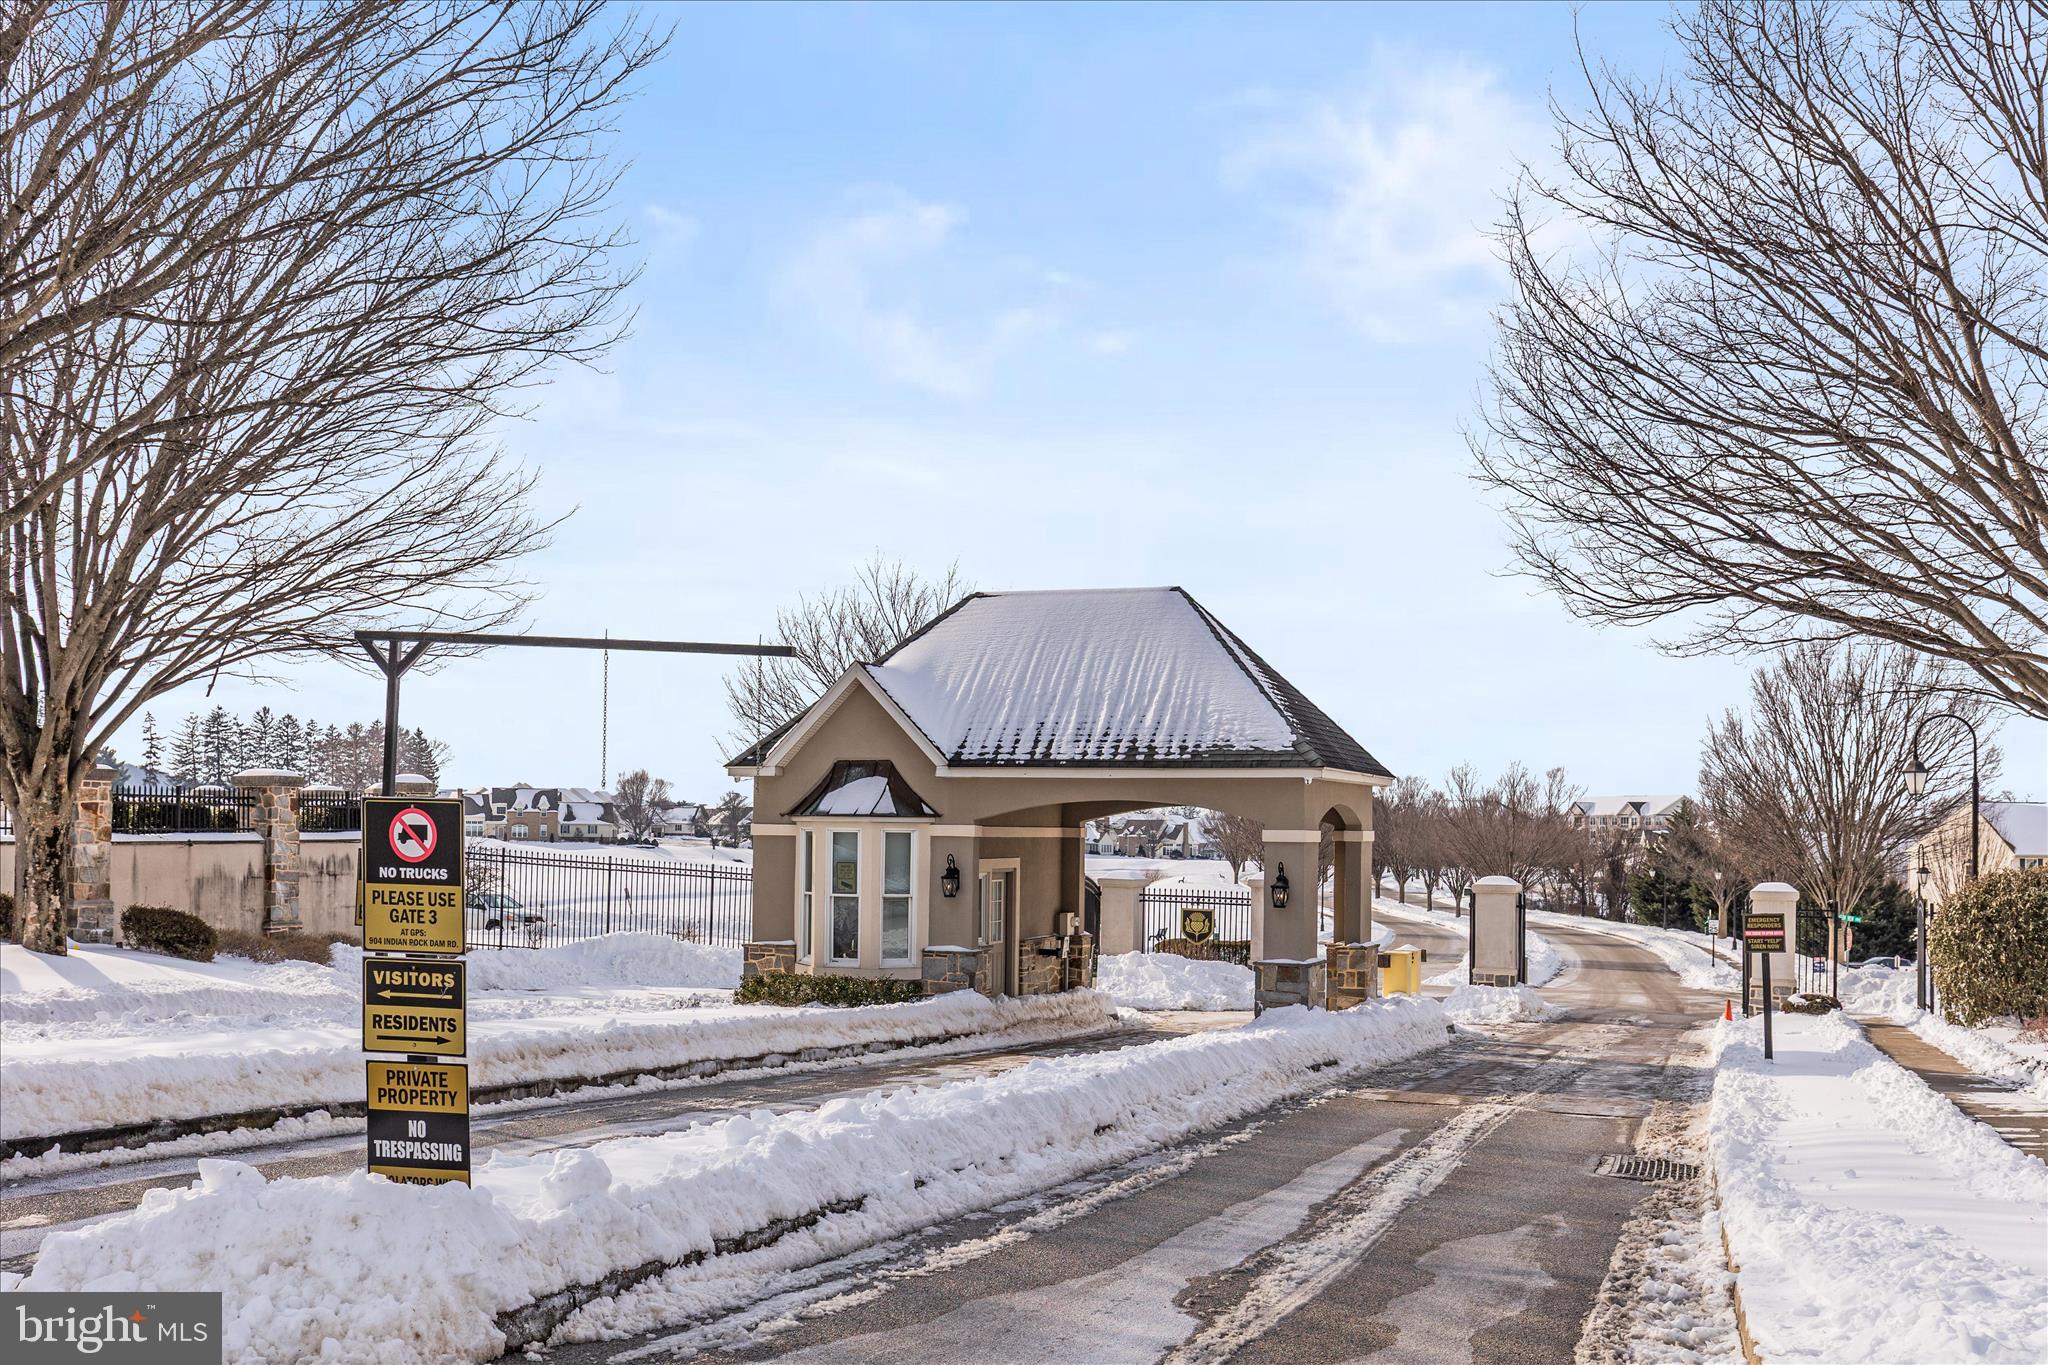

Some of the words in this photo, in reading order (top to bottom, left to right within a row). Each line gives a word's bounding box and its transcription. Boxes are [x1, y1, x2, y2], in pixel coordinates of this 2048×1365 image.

[379, 866, 397, 878] NO
[400, 867, 448, 880] TRUCKS
[372, 890, 424, 906] PLEASE
[428, 892, 456, 907] USE
[390, 908, 425, 924] GATE
[429, 910, 437, 925] 3
[410, 929, 426, 937] GPS:
[369, 937, 382, 945] 904
[384, 938, 407, 946] INDIAN
[409, 939, 428, 947] ROCK
[430, 940, 445, 948] DAM
[447, 940, 459, 948] RD.
[373, 970, 455, 988] VISITORS
[372, 1014, 457, 1033] RESIDENTS
[386, 1070, 448, 1087] PRIVATE
[378, 1088, 457, 1107] PROPERTY
[408, 1120, 426, 1138] NO
[374, 1140, 462, 1162] TRESPASSING
